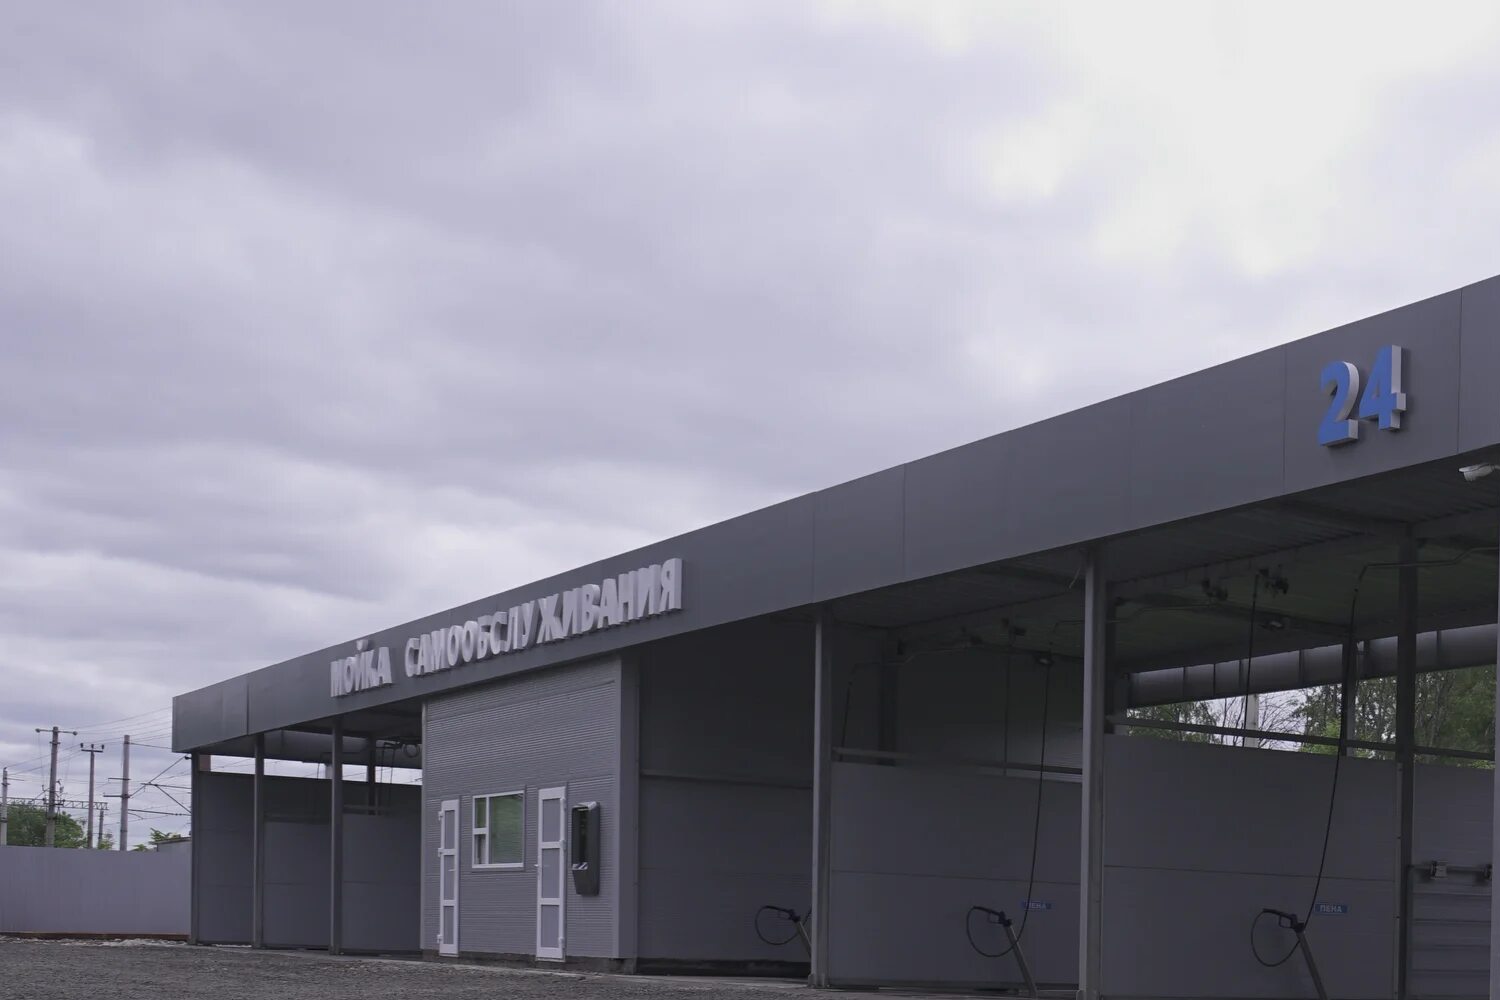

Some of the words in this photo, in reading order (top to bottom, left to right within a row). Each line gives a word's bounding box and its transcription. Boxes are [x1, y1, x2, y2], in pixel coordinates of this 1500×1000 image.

[1318, 344, 1407, 447] 24
[330, 639, 393, 698] МОЙКА
[405, 557, 684, 678] САМООБСЛУЖИВАНИЯ
